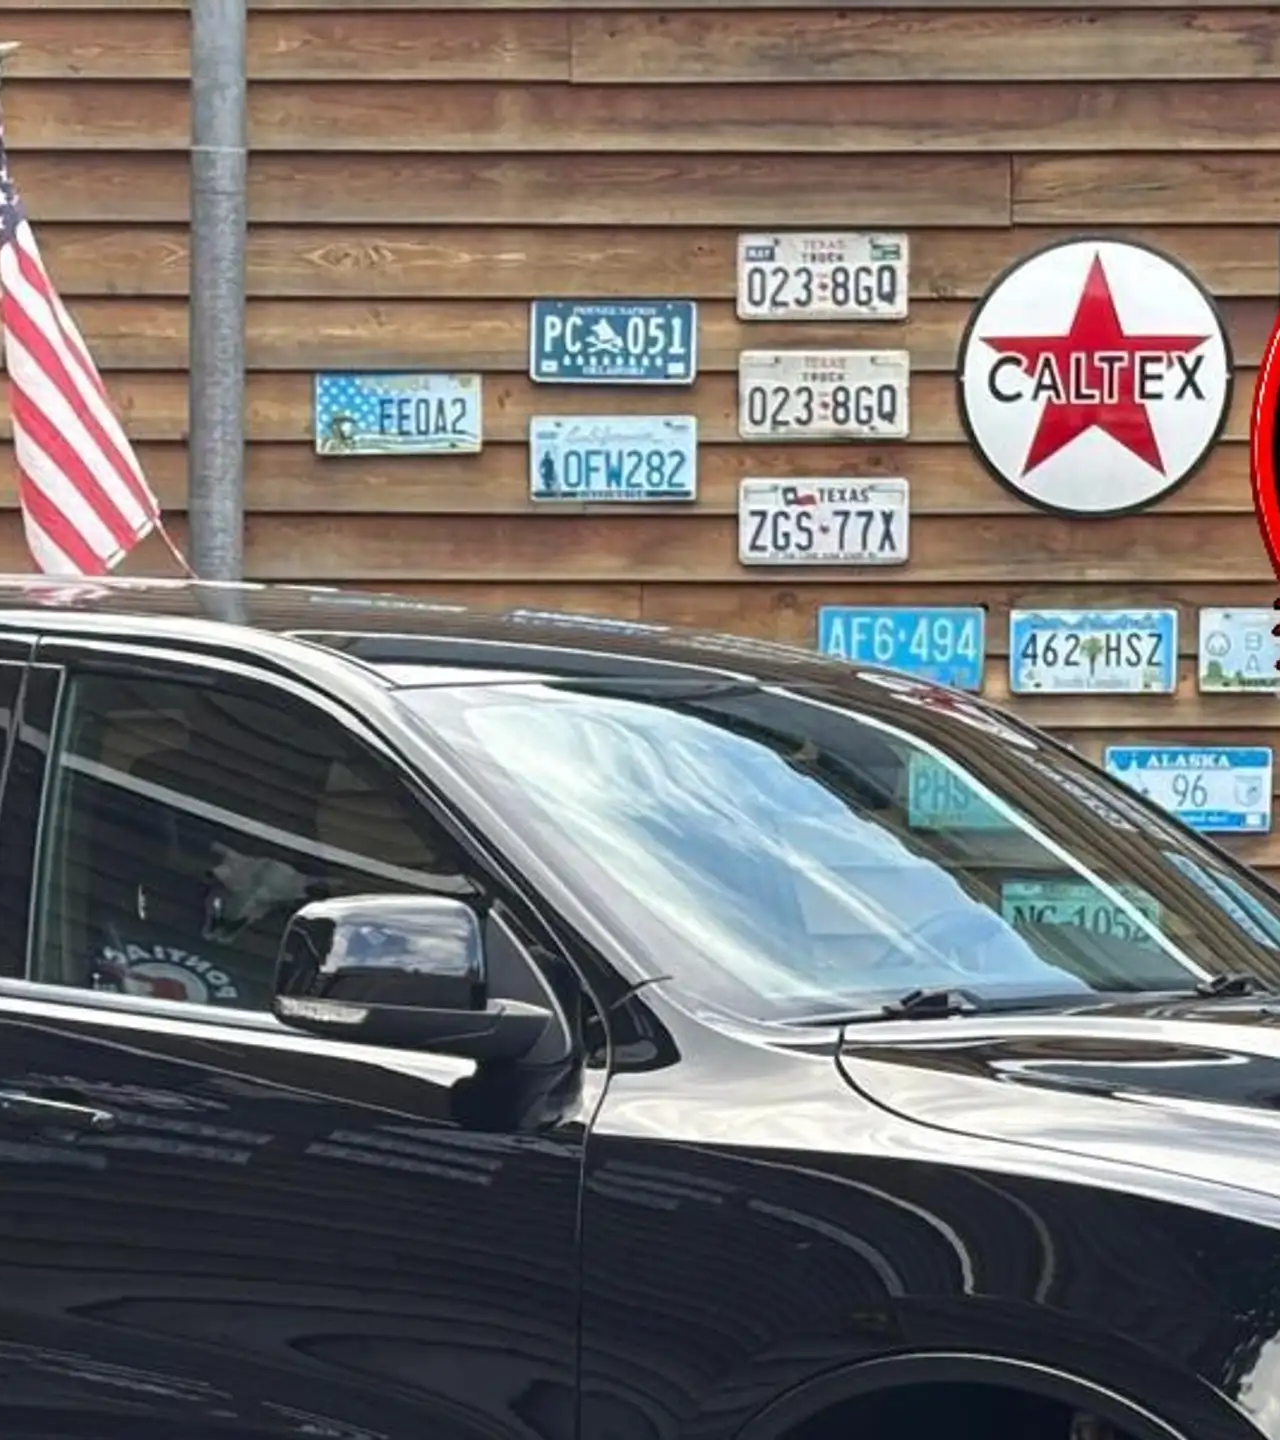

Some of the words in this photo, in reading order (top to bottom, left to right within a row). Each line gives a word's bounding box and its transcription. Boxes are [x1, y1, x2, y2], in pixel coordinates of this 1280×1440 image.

[543, 314, 583, 354] PC
[626, 316, 686, 355] 051
[987, 352, 1207, 403] CALTEX
[816, 487, 870, 502] TEXAS
[1021, 632, 1082, 667] 462
[1104, 632, 1164, 667] HSZ
[1145, 753, 1231, 769] ALASKA
[1172, 773, 1208, 808] 96
